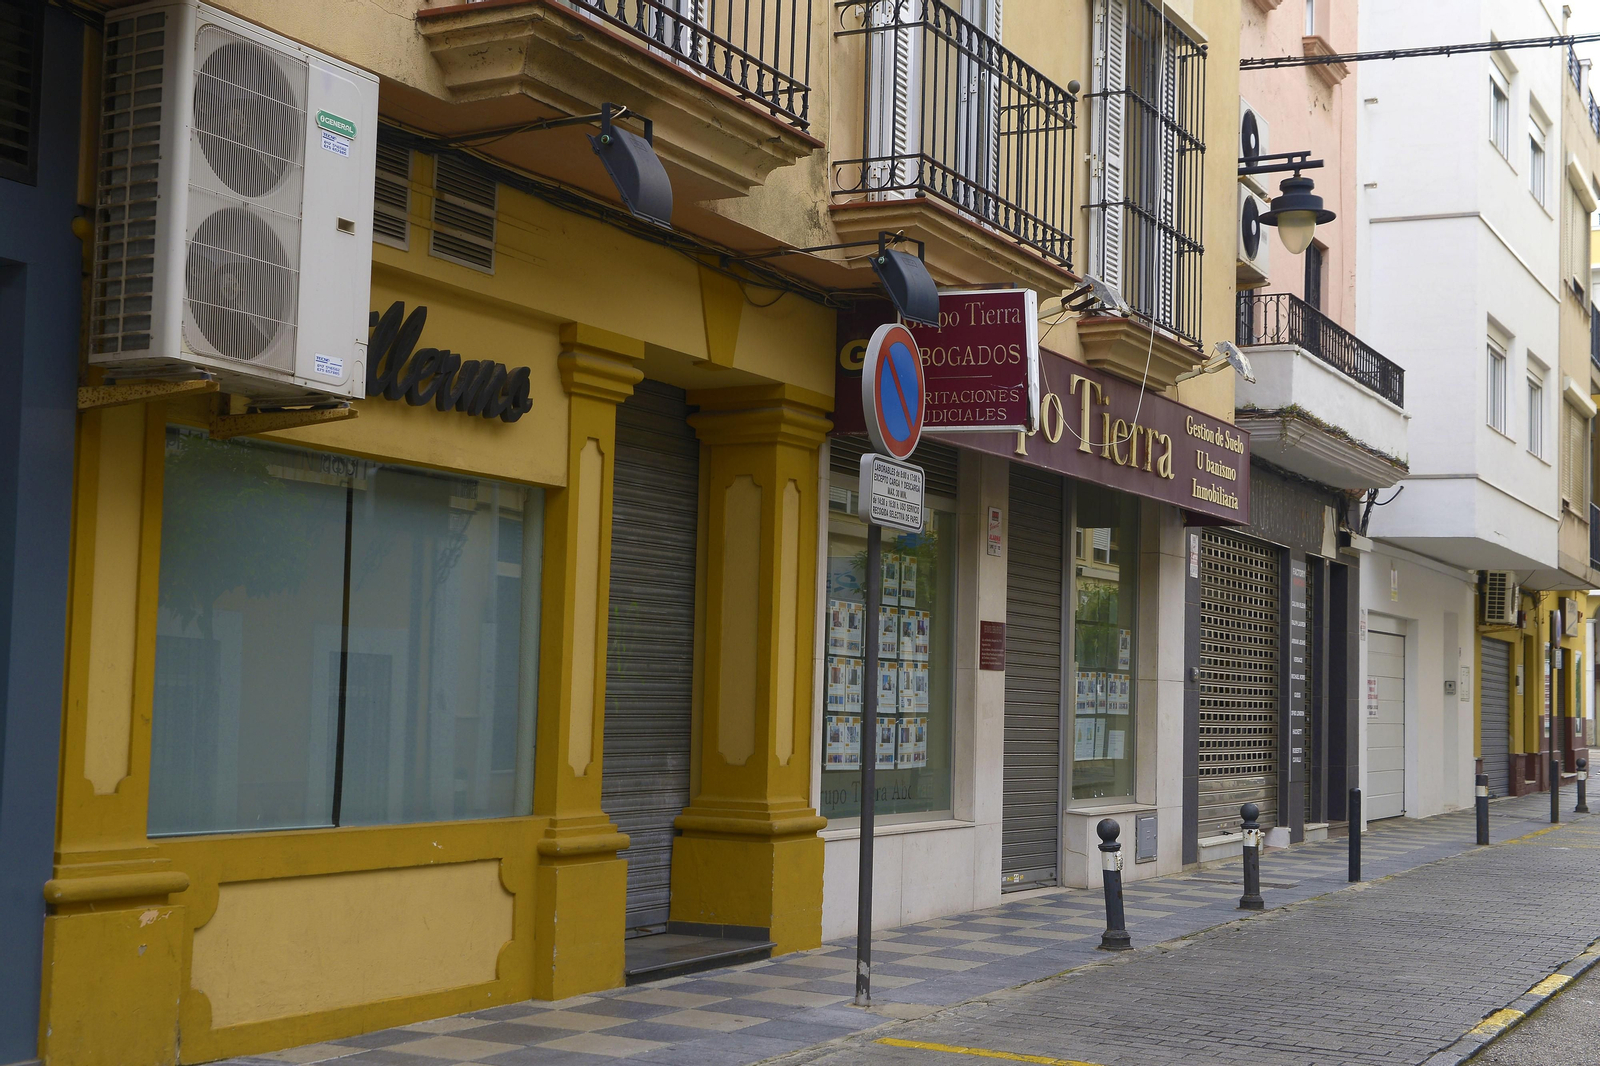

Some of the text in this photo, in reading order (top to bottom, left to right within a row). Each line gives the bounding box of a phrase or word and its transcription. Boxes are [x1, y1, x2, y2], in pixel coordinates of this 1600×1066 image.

[325, 117, 354, 133] GENERAL
[965, 302, 1022, 327] Tierra
[367, 301, 533, 422] llermo
[921, 344, 1021, 366] BOGADOS
[924, 389, 1020, 405] RITACIONES
[922, 408, 1007, 423] UDICIALES
[1070, 374, 1175, 480] Tierra
[1186, 415, 1244, 454] Gestion de Suelo
[874, 462, 896, 476] LABORABLES
[874, 472, 888, 485] EXCEPTO
[889, 476, 900, 488] CARGA
[904, 481, 920, 493] DESCARGA
[1192, 478, 1238, 510] Inmobiliaria
[873, 505, 889, 517] RECOGIDA
[889, 508, 904, 521] SELECTIVA
[910, 514, 919, 524] PAPEL
[906, 504, 920, 515] SERVICIO
